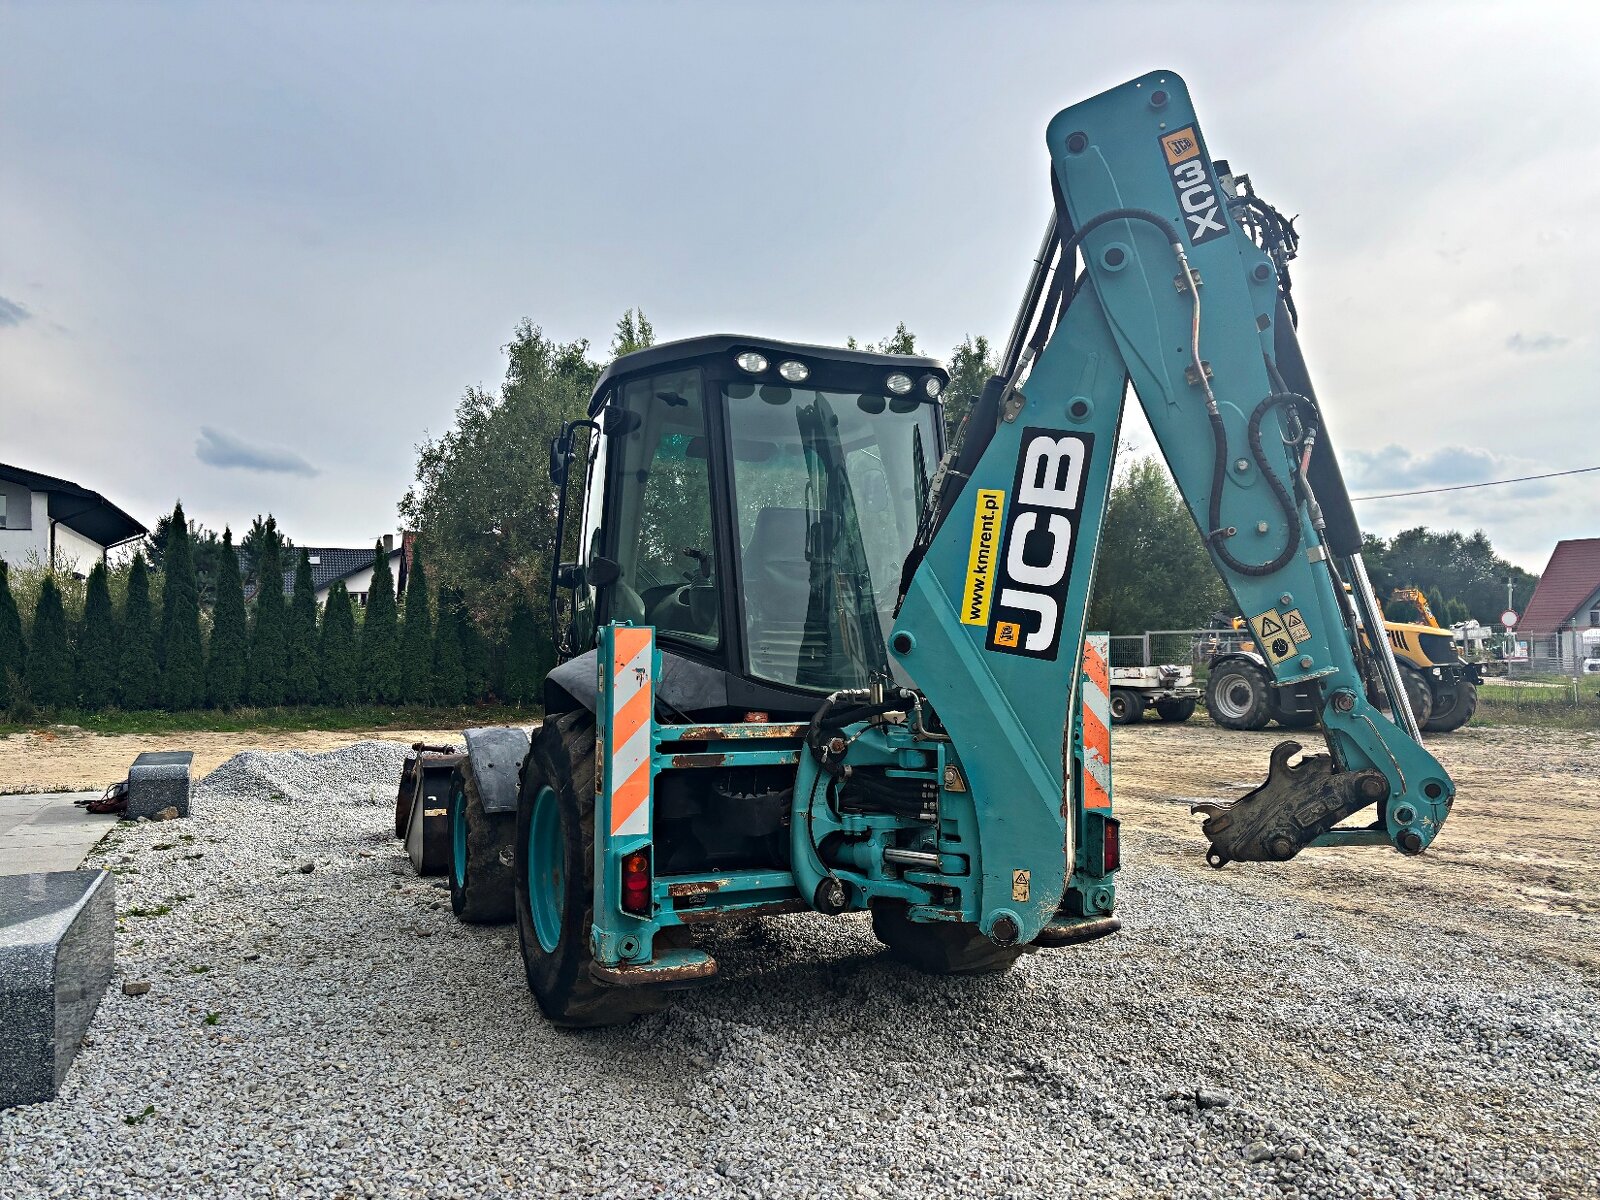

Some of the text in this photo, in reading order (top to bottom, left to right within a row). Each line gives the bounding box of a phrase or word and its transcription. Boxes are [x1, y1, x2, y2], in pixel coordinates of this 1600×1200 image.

[1173, 159, 1226, 240] 3CX
[969, 494, 1000, 621] www.kmrent.pl
[1000, 436, 1085, 652] JCB
